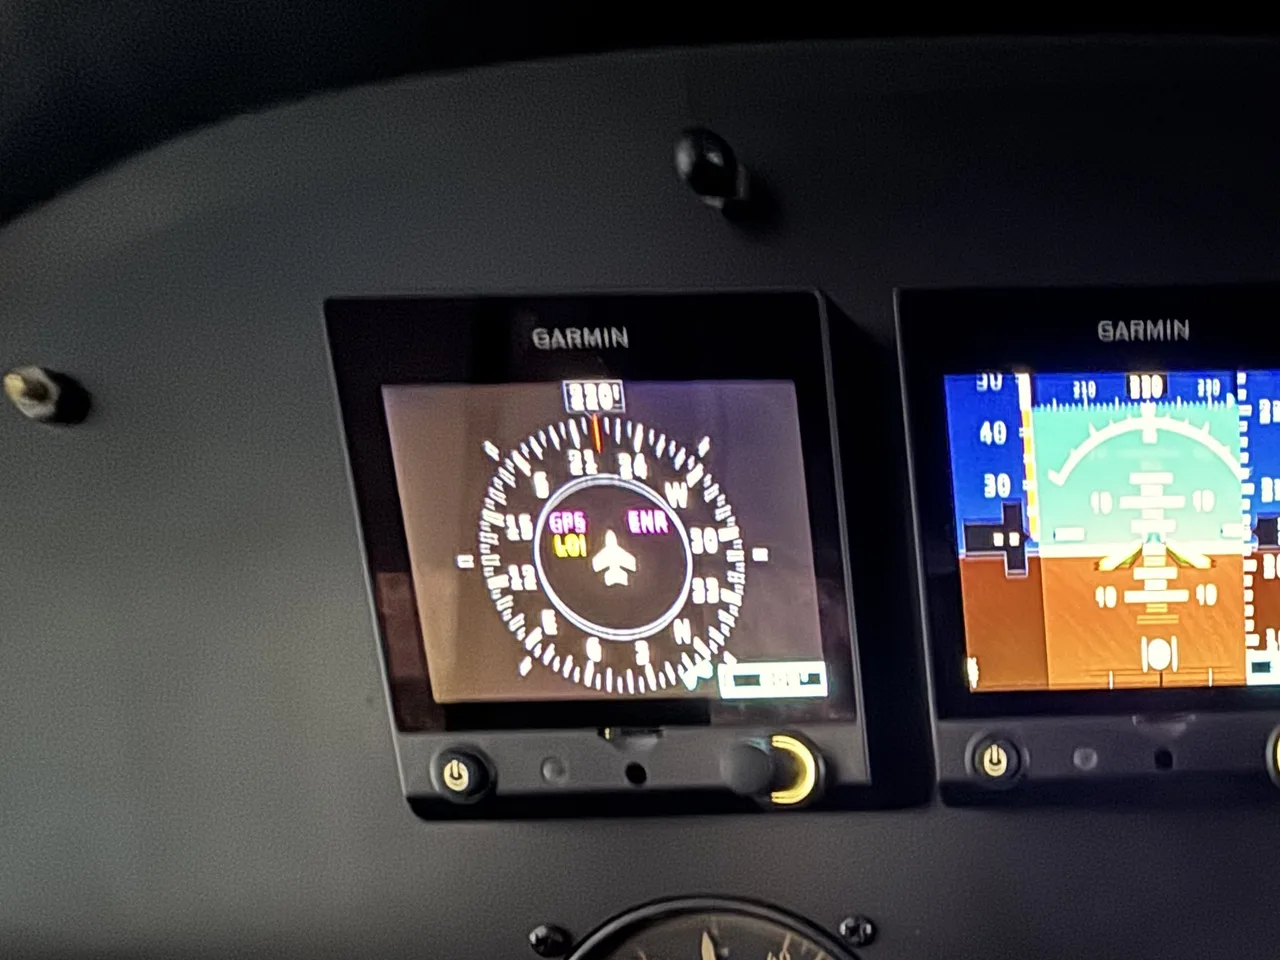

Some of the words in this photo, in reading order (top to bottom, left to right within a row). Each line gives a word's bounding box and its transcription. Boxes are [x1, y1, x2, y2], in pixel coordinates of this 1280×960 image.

[532, 326, 629, 350] GARMIN
[1098, 319, 1190, 342] GARMIN
[979, 421, 1007, 445] 40
[567, 449, 598, 476] 21
[618, 452, 648, 480] 24
[664, 481, 688, 508] W
[983, 474, 1011, 498] 30
[505, 513, 533, 541] 15
[549, 510, 587, 534] GPS
[627, 509, 669, 533] ENR
[690, 527, 719, 554] 30
[508, 564, 537, 591] 12
[1095, 585, 1117, 608] 10
[1196, 583, 1217, 606] 10
[673, 618, 691, 645] N
